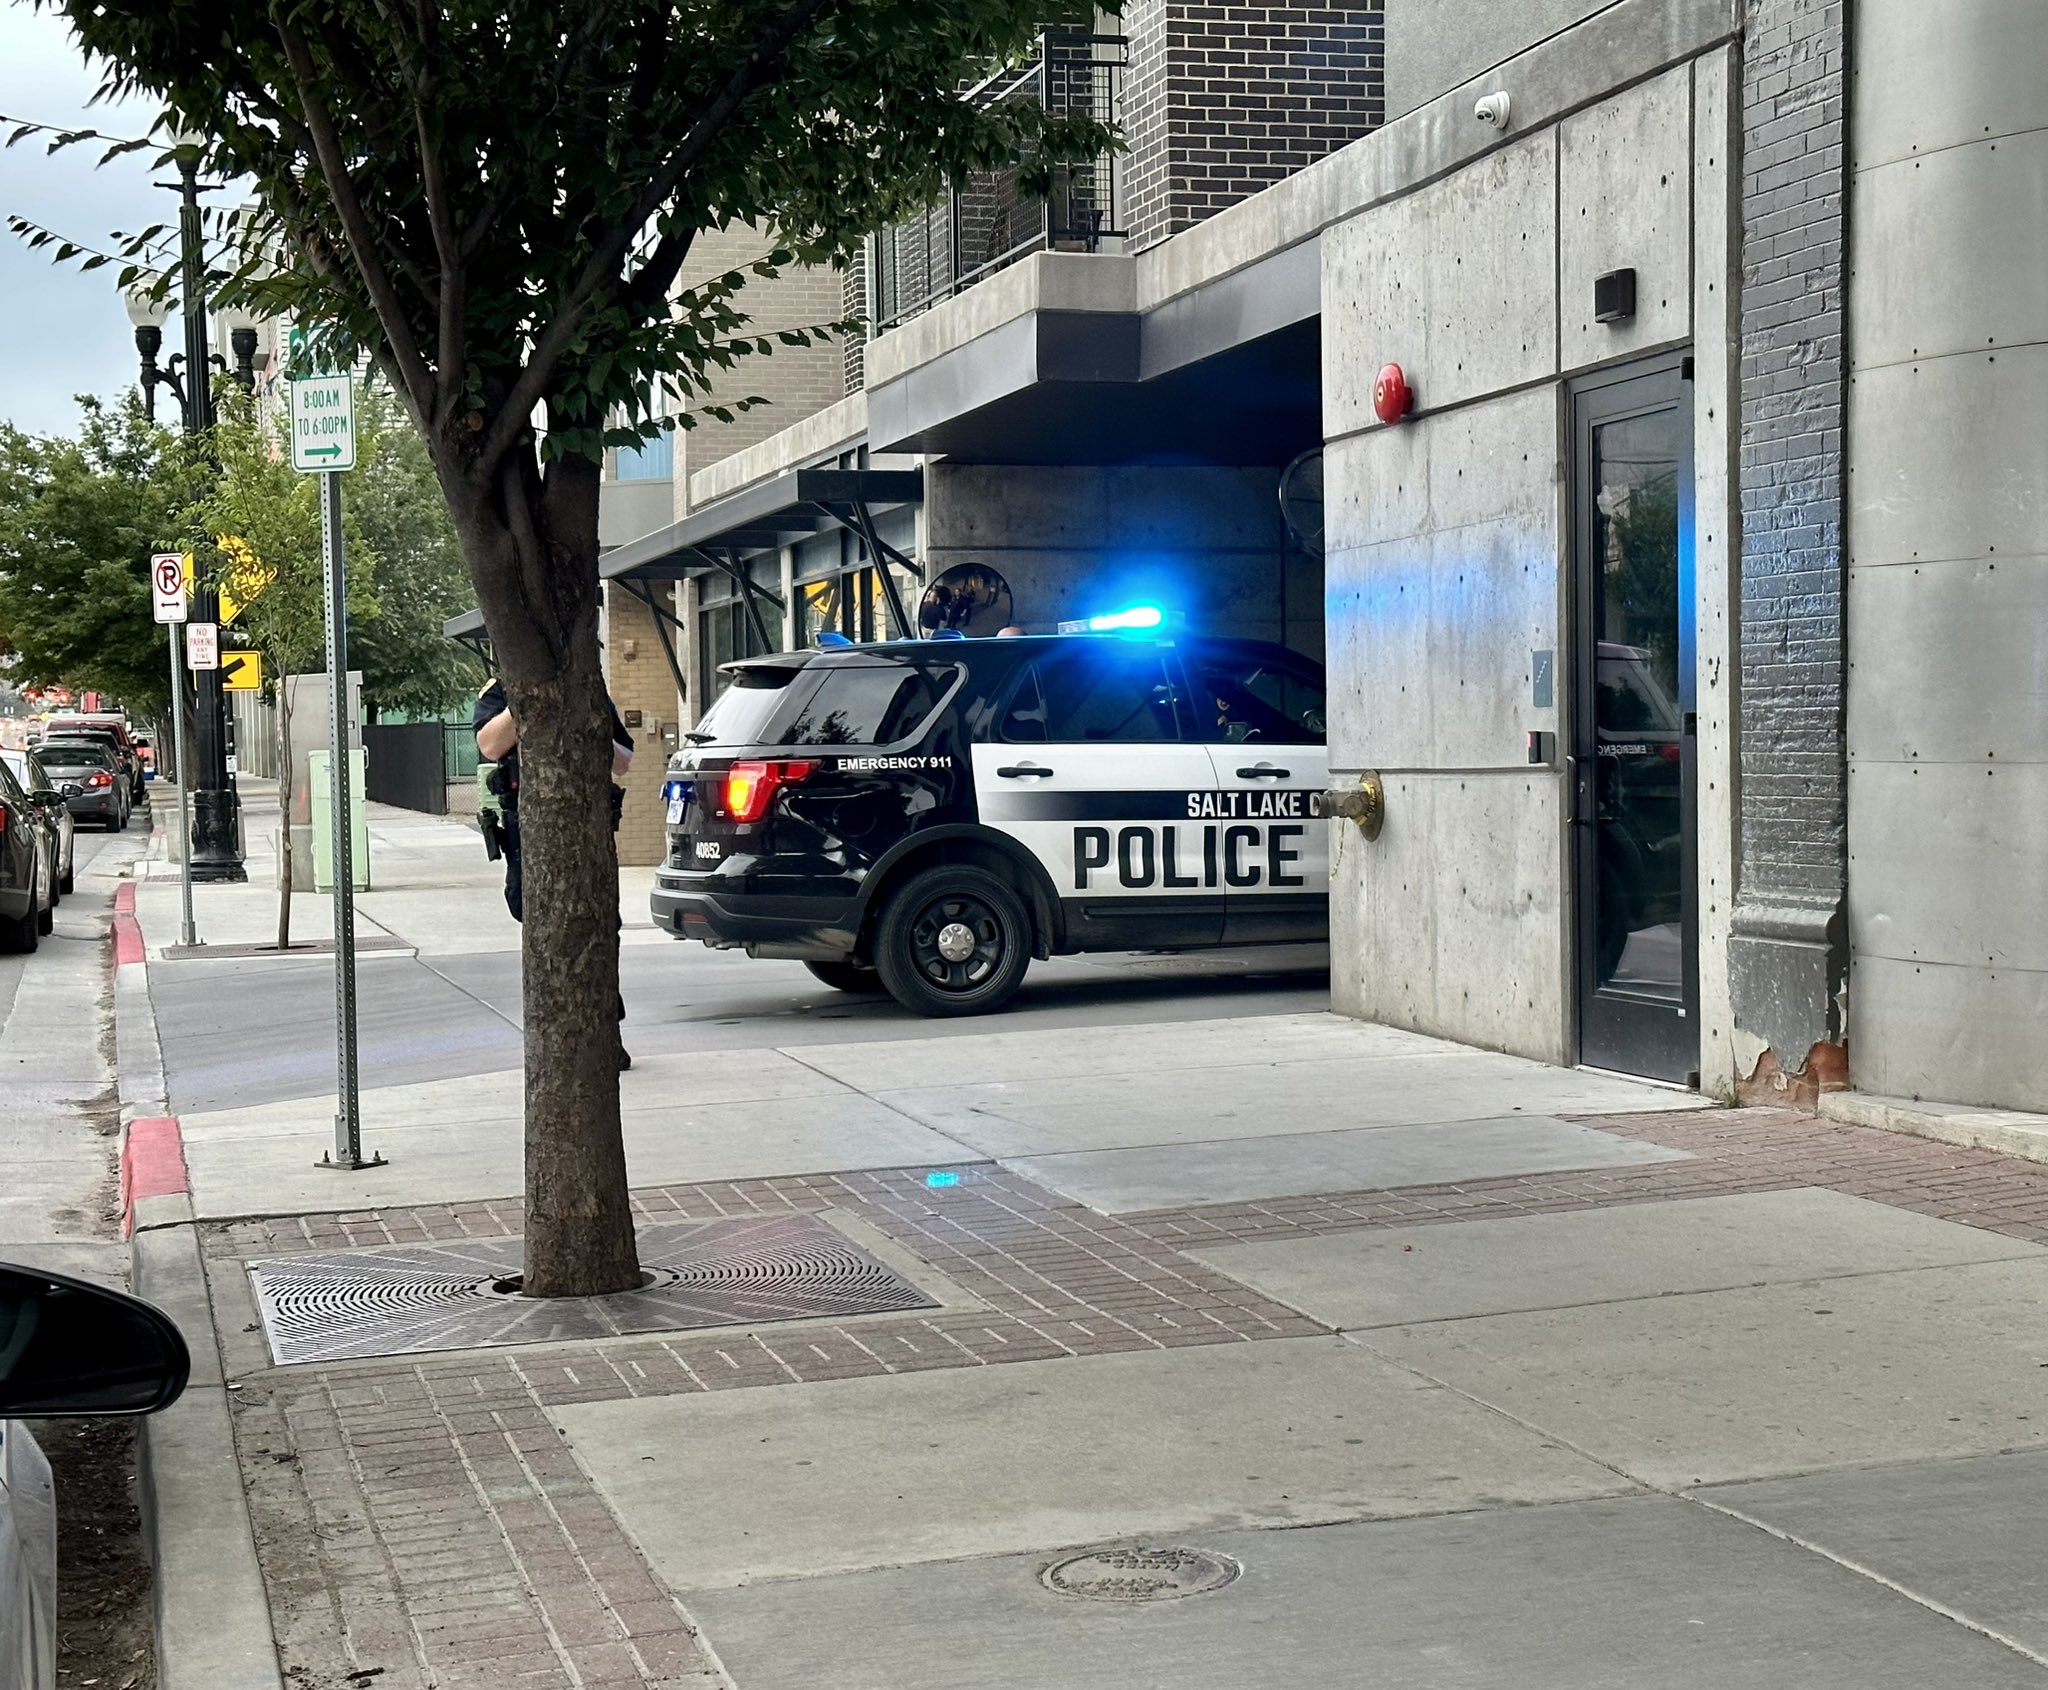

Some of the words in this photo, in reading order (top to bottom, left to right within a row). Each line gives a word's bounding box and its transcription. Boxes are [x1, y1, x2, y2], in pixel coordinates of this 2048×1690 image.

[304, 389, 340, 409] 8:00AM
[298, 418, 309, 436] TO
[313, 416, 347, 435] 6:00PM
[196, 627, 208, 637] NO
[190, 638, 214, 647] PARKING
[838, 758, 928, 770] EMERGENCY
[930, 756, 952, 768] 911
[1187, 792, 1239, 818] SALT
[1247, 792, 1302, 817] LAKE
[696, 842, 721, 859] 40852
[1074, 825, 1306, 889] POLICE
